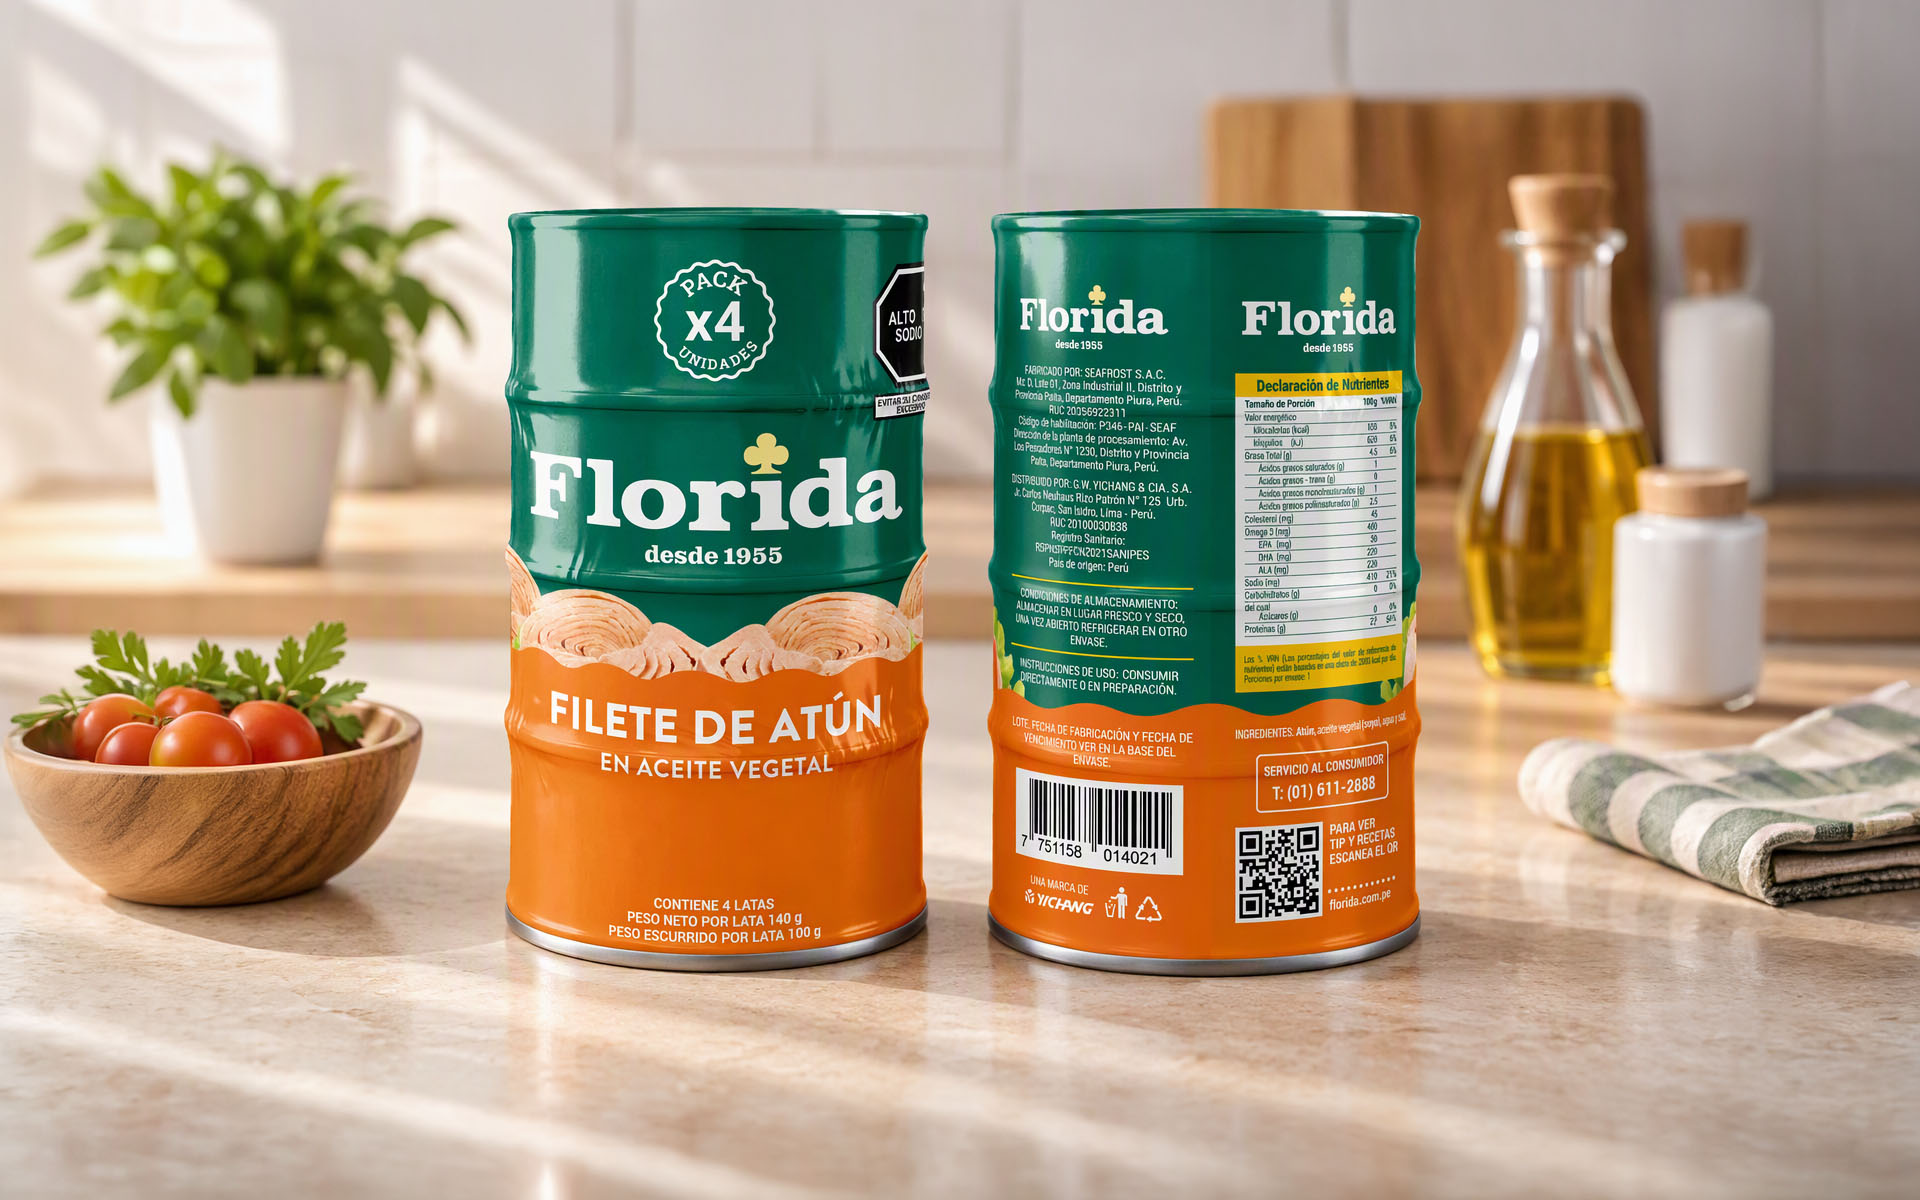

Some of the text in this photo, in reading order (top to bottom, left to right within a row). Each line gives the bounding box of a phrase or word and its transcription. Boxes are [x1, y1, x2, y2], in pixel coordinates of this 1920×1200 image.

[680, 270, 748, 298] PACK
[685, 300, 745, 342] x4
[889, 309, 916, 326] ALTO
[1019, 297, 1169, 336] Florida
[1242, 300, 1397, 336] Florida
[1055, 339, 1103, 350] desde 1955
[1303, 342, 1354, 353] desde 1955
[678, 339, 759, 371] UNIDADES
[1085, 368, 1132, 378] SEAFROST
[1135, 369, 1166, 379] S.A.C.
[1138, 383, 1173, 393] Distrito
[1176, 385, 1182, 395] y
[1257, 378, 1389, 393] Declaración de Nutrientes
[1066, 393, 1124, 405] Departamento
[1245, 400, 1274, 408] Tamaño
[1288, 399, 1315, 408] Porción
[1060, 432, 1083, 443] planta
[1086, 433, 1095, 442] de
[1172, 437, 1188, 446] Av.
[1143, 450, 1189, 459] Provincia
[530, 448, 903, 531] Florida
[1093, 480, 1135, 492] YICHANG
[1138, 482, 1145, 492] &
[1148, 482, 1169, 493] CIA.
[1096, 494, 1125, 504] Patrón
[1143, 496, 1161, 506] 125
[1167, 496, 1187, 506] Urb.
[1058, 504, 1072, 514] San
[1084, 534, 1125, 545] Sanitario:
[644, 544, 783, 565] desde 1955
[1066, 560, 1075, 568] de
[1108, 562, 1128, 572] Perú
[1071, 594, 1082, 604] DE
[1084, 595, 1178, 609] ALMACENAMIENTO:
[1061, 607, 1071, 617] EN
[1073, 608, 1102, 619] LUGAR
[1104, 610, 1142, 622] FRESCO
[1145, 612, 1150, 622] Y
[1046, 618, 1079, 631] ABIERTO
[1082, 622, 1139, 635] REFRIGERAR
[1143, 626, 1155, 636] EN
[1158, 627, 1187, 637] OTRO
[1070, 635, 1108, 648] ENVASE.
[1020, 658, 1178, 681] INSTRUCCIONES DE USO: CONSUMIR
[1021, 671, 1078, 689] DIRECTAMENTE
[1088, 681, 1100, 691] EN
[1103, 682, 1177, 695] PREPARACIÓN.
[550, 690, 882, 745] FILETE DE ATÚN
[1032, 720, 1193, 743] FECHA DE FABRICACIÓN Y FECHA DE
[1079, 740, 1096, 751] VER
[1099, 742, 1110, 753] EN
[1113, 745, 1125, 755] LA
[1128, 745, 1153, 756] BASE
[1157, 747, 1176, 757] DEL
[600, 752, 834, 780] EN ACEITE VEGETAL
[1074, 755, 1111, 768] ENVASE.
[1264, 754, 1383, 777] SERVICIO AL CONSUMIDOR
[1272, 776, 1375, 802] T: (01) 611-2888
[1330, 818, 1375, 835] PARA VER
[1330, 827, 1395, 849] TIP Y RECETAS
[1021, 834, 1156, 865] 7 751158 014021
[1330, 845, 1384, 864] ESCANEA EL
[1030, 874, 1088, 895] UNA MARCA DE
[653, 897, 775, 911] CONTIENE 4 LATAS
[1329, 889, 1391, 911] florida.com.pe
[627, 911, 803, 927] PESO NETO POR LATA 140 g
[609, 924, 821, 944] PESO ESCURRIDO POR LATA 100 g
